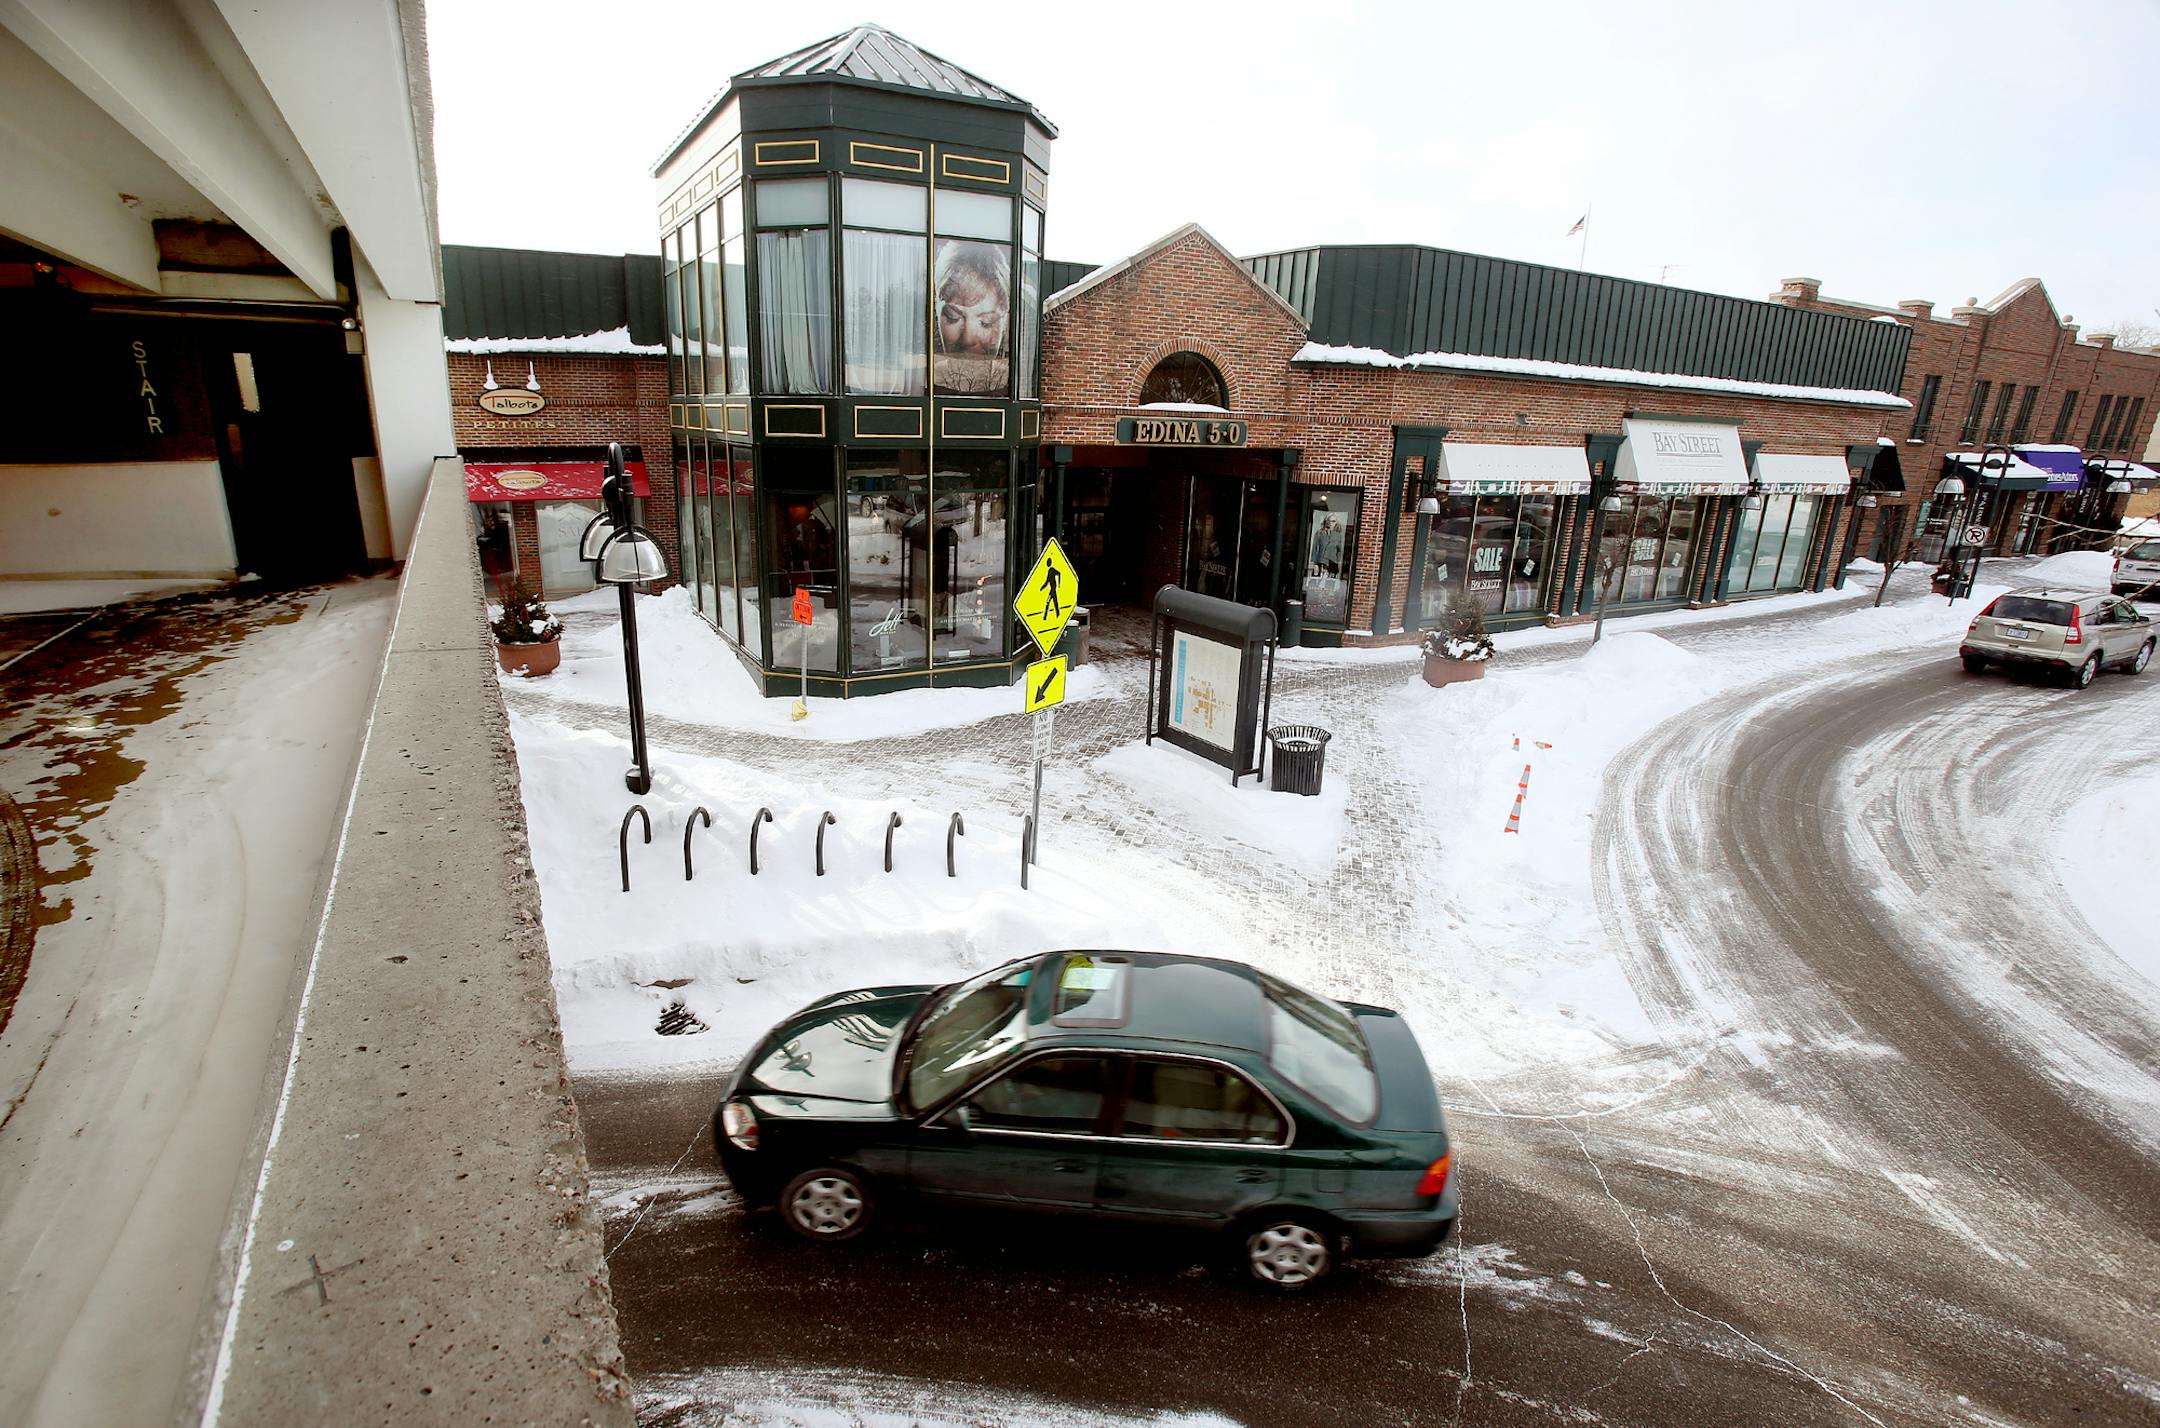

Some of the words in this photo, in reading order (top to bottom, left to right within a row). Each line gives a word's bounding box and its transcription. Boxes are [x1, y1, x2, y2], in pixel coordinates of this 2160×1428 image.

[131, 340, 164, 434] STAIR
[484, 395, 541, 409] Talbots
[1135, 420, 1201, 443] EDINA
[1652, 431, 1678, 453] BAY
[1678, 433, 1721, 454] STREET
[1474, 547, 1503, 572] SALE
